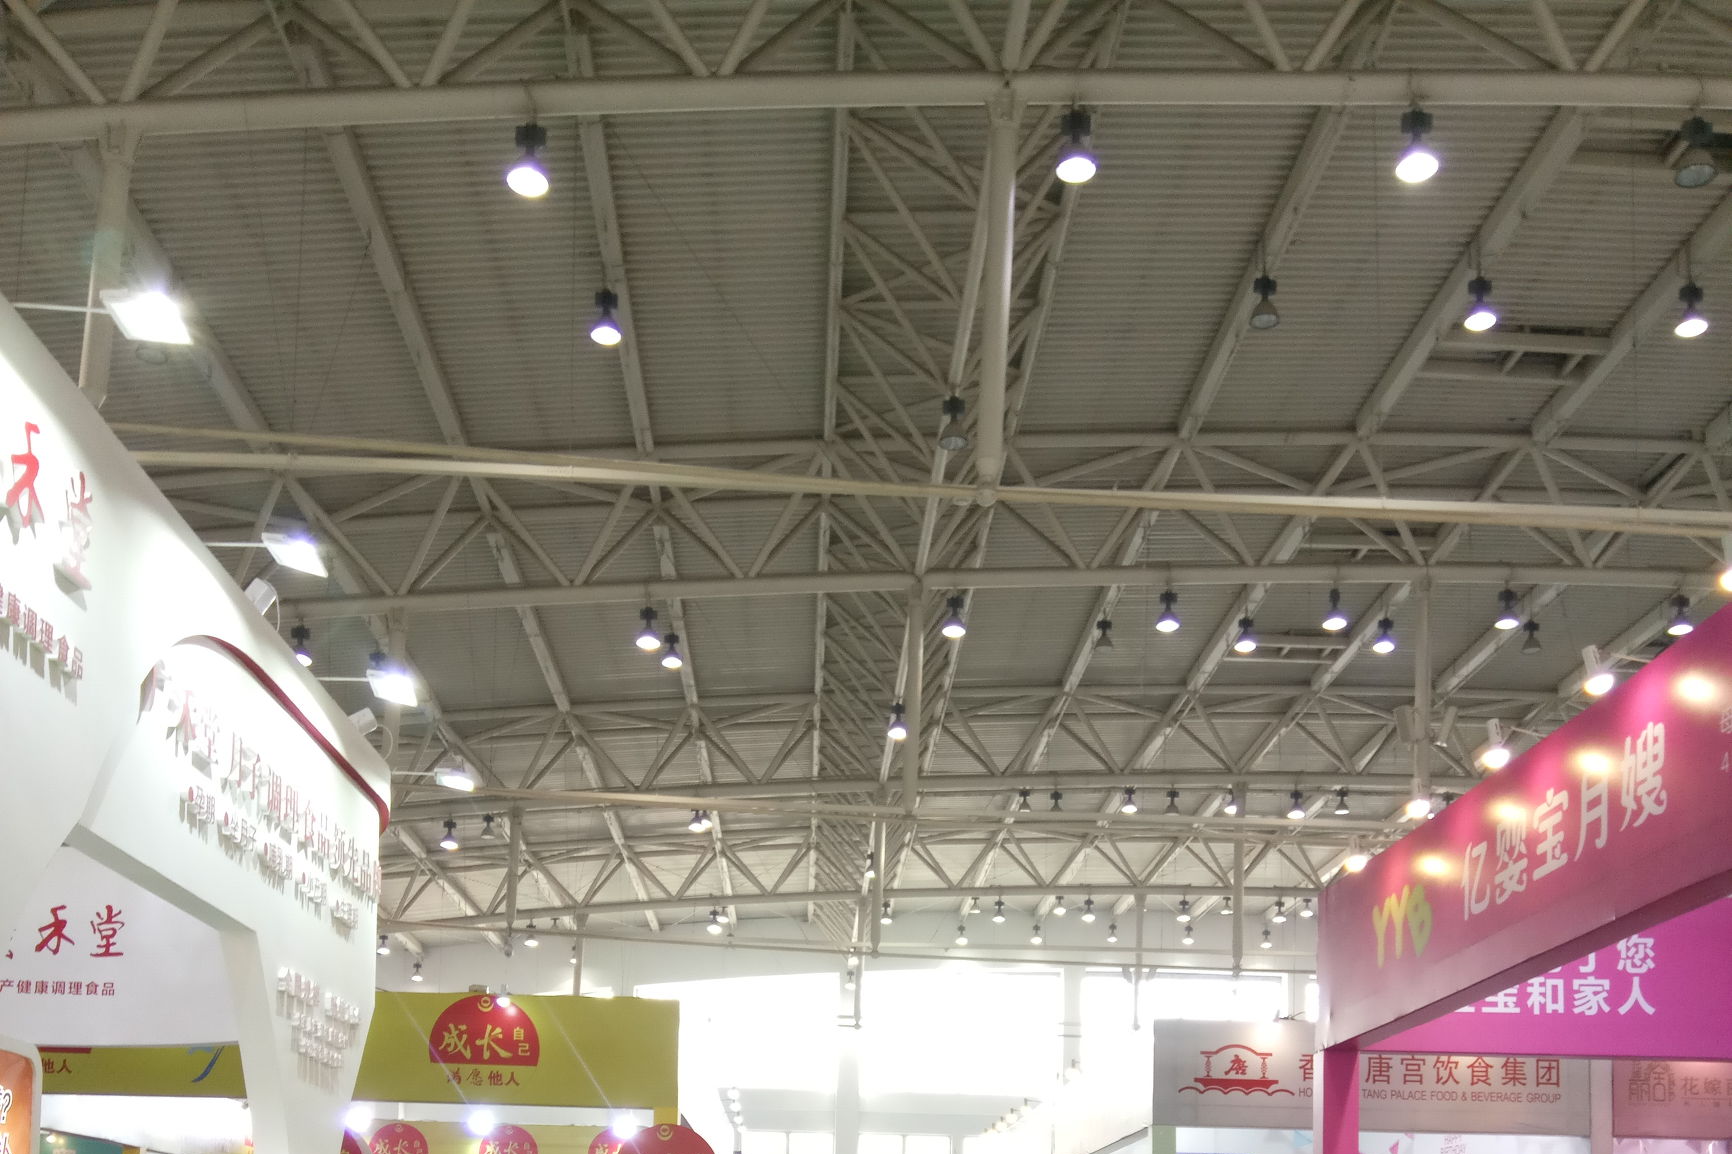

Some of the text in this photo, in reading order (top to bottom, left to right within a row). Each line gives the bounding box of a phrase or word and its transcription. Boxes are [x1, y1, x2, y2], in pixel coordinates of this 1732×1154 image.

[0, 583, 83, 681] 康调理食品
[5, 904, 125, 959] 禾堂
[0, 978, 116, 997] 产健康调理食品
[1456, 976, 1656, 1016] 宝和家人
[438, 1022, 530, 1060] 成长 自己
[1364, 1054, 1561, 1088] 唐宫饮食集团
[1362, 1088, 1387, 1100] TANG
[1390, 1089, 1427, 1101] PALACE
[1430, 1090, 1458, 1101] FOOD
[1461, 1091, 1467, 1101] &
[1471, 1091, 1523, 1103] BEVERAGE
[1526, 1092, 1561, 1104] GROUP
